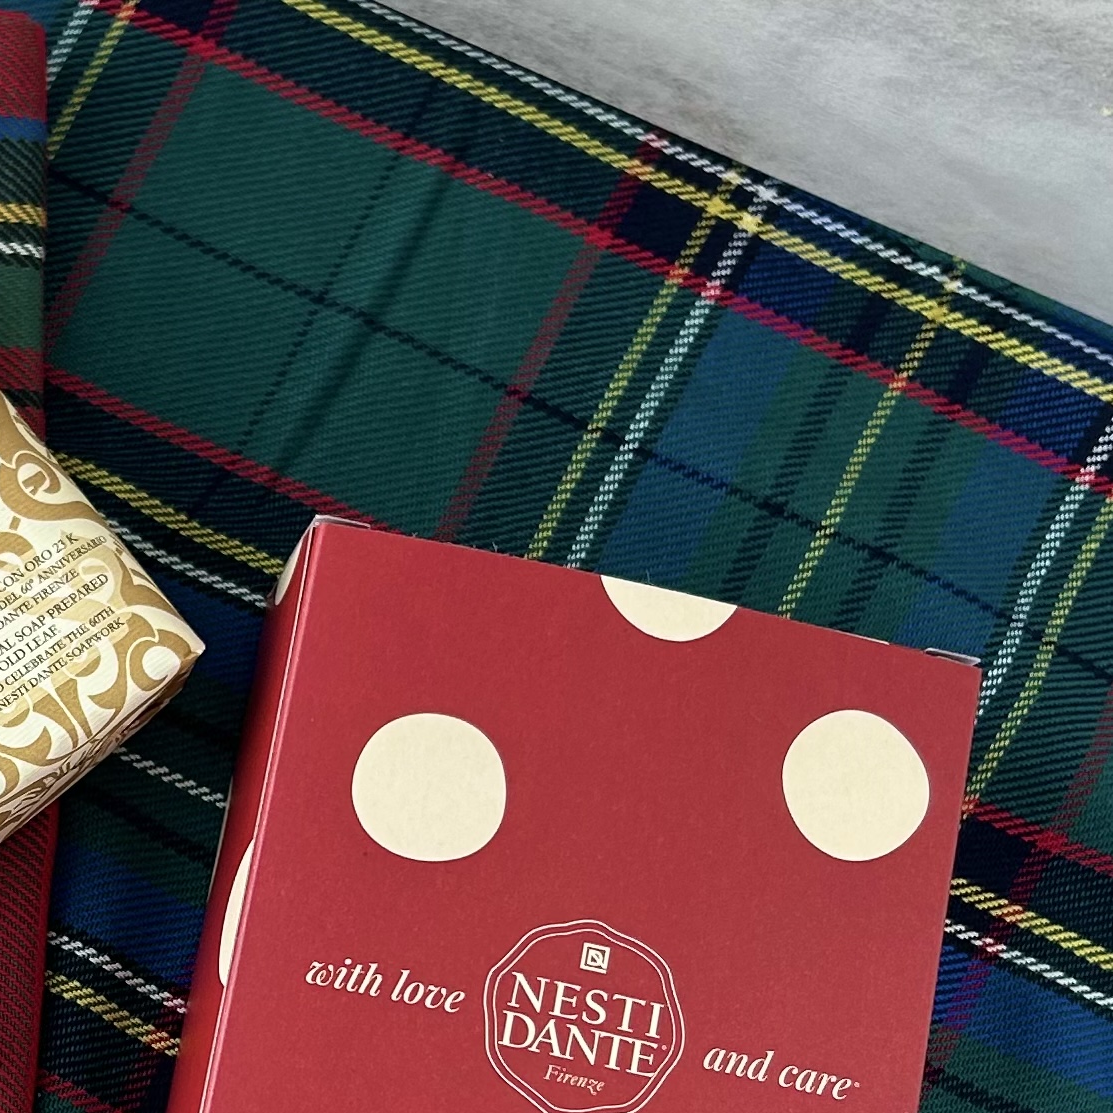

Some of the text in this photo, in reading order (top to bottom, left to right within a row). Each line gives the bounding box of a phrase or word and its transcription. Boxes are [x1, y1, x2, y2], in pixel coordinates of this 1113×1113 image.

[22, 547, 54, 573] ORO
[30, 566, 80, 605] FIRENZE
[34, 532, 107, 584] ANNIVERSARIO
[13, 612, 49, 643] SOAP
[45, 571, 110, 620] PREPARED
[2, 637, 67, 687] CELEBRATE
[64, 621, 90, 644] THE
[87, 604, 115, 628] 60TH
[27, 656, 68, 689] DANTE
[64, 615, 125, 662] SOAPWORK
[304, 957, 467, 1014] with love
[508, 971, 665, 1039] NESTI
[497, 1011, 663, 1078] DANTE
[703, 1044, 775, 1083] and
[542, 1064, 605, 1096] Firenze
